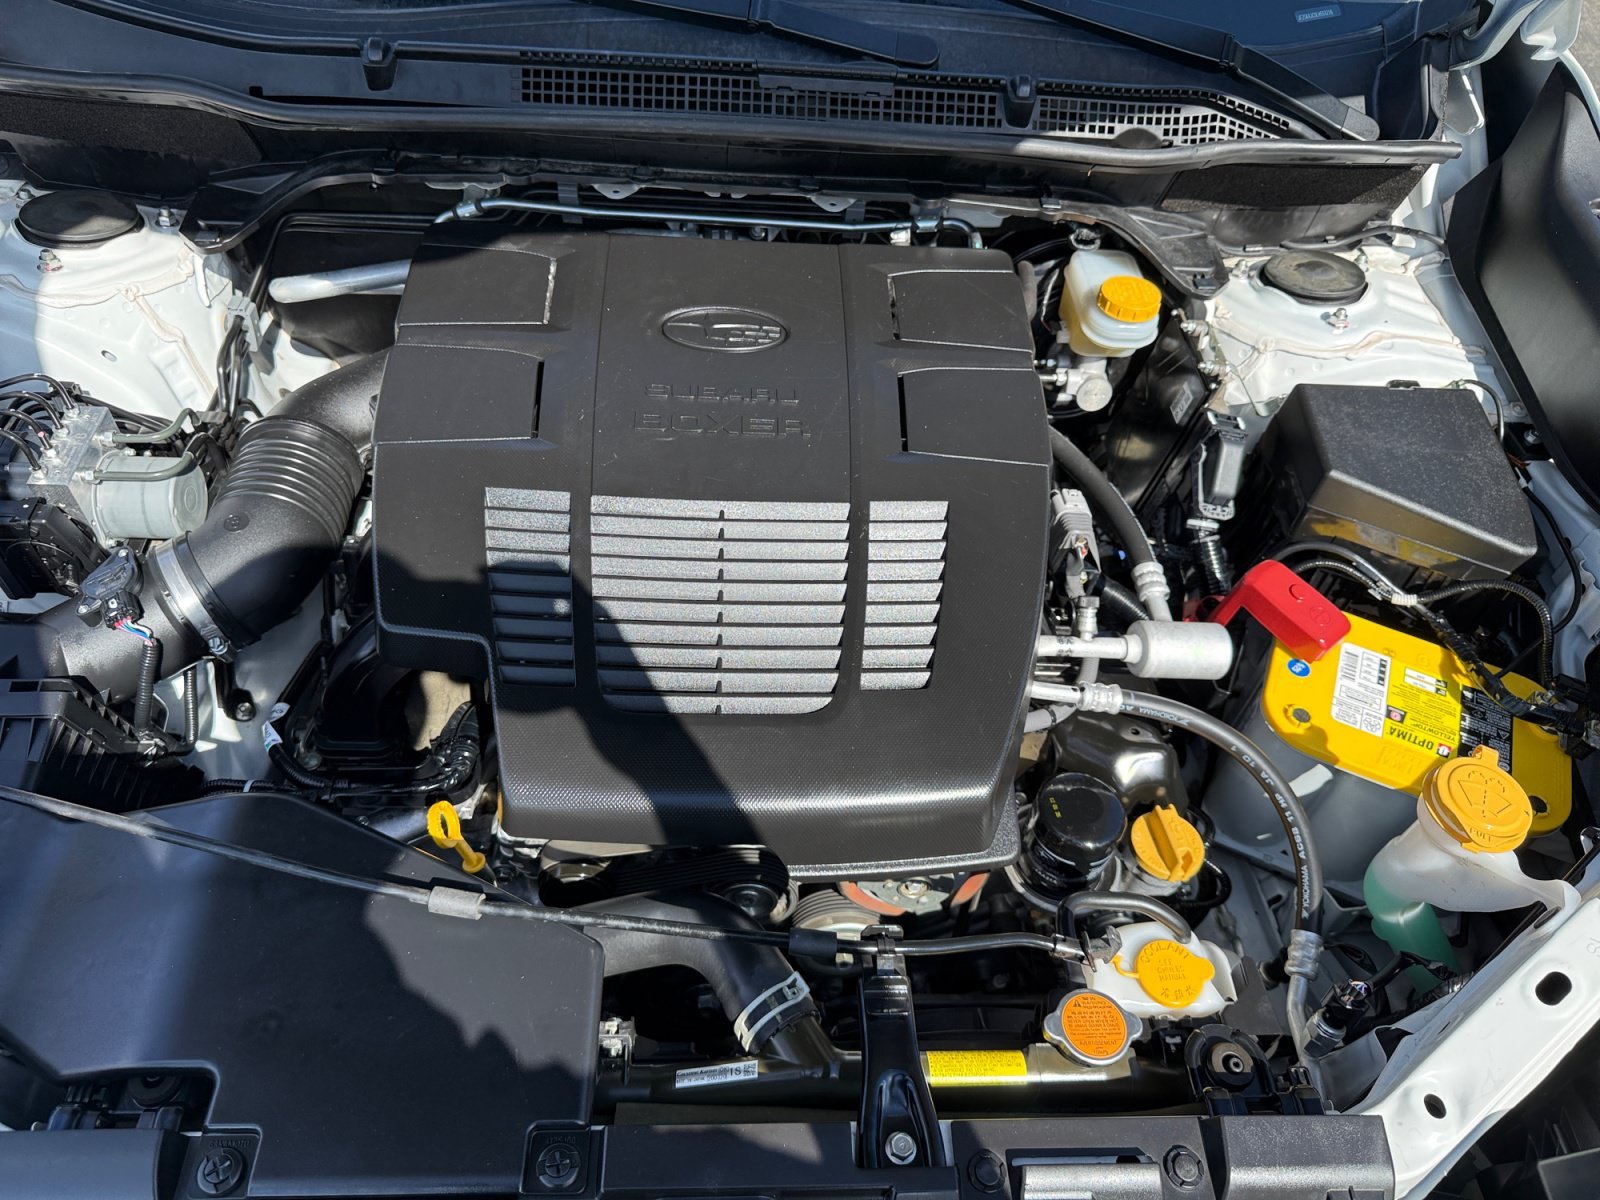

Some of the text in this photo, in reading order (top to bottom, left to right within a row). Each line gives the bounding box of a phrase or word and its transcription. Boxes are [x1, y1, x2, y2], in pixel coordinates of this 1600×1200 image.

[645, 383, 799, 404] SUBARU
[634, 411, 811, 437] BOXER
[1139, 706, 1178, 721] YOKOHAMA
[1389, 726, 1435, 751] OPTIMA
[1301, 864, 1311, 907] YOKOHAMA
[1140, 941, 1190, 964] COOLANT
